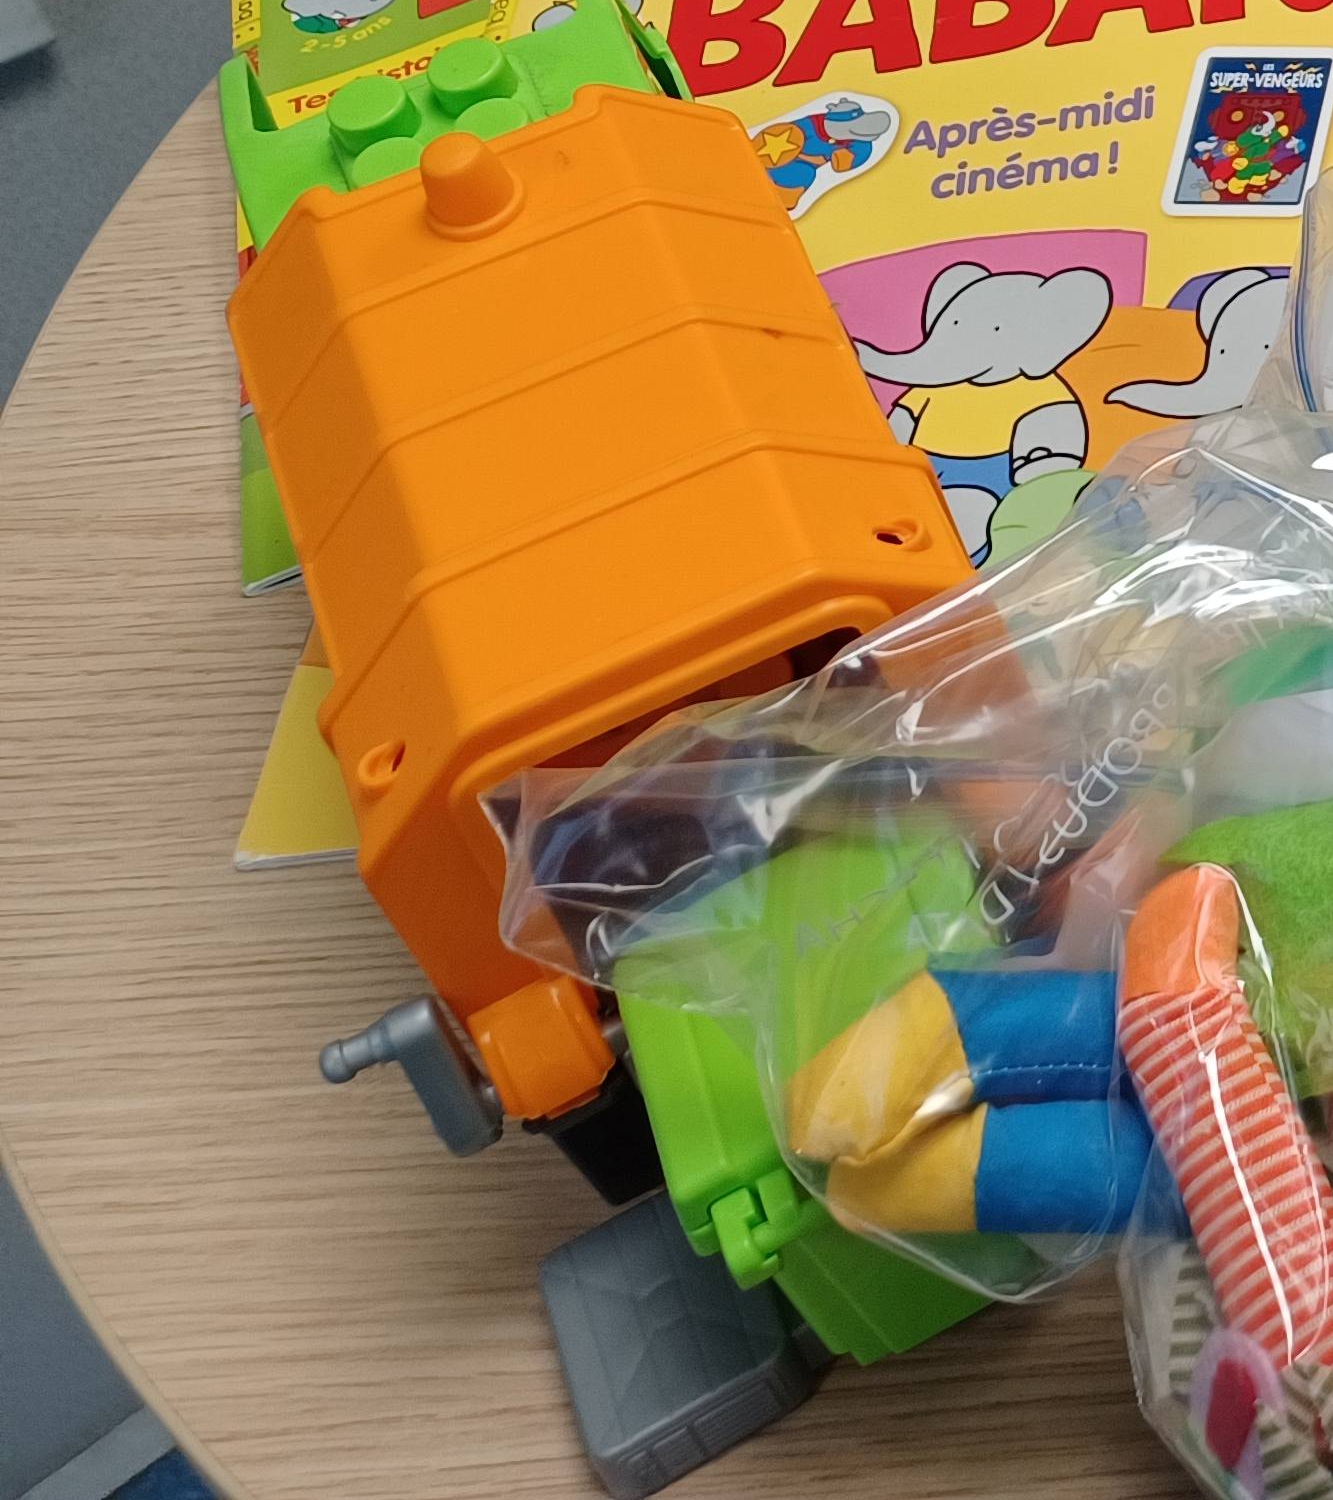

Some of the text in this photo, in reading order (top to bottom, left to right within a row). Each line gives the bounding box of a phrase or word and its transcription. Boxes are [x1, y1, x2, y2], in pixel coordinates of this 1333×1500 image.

[300, 14, 392, 54] 2-5 ans
[1209, 69, 1325, 95] SUPER-VENGEURS
[904, 88, 1157, 156] Après-midi
[929, 142, 1121, 201] cinéma !
